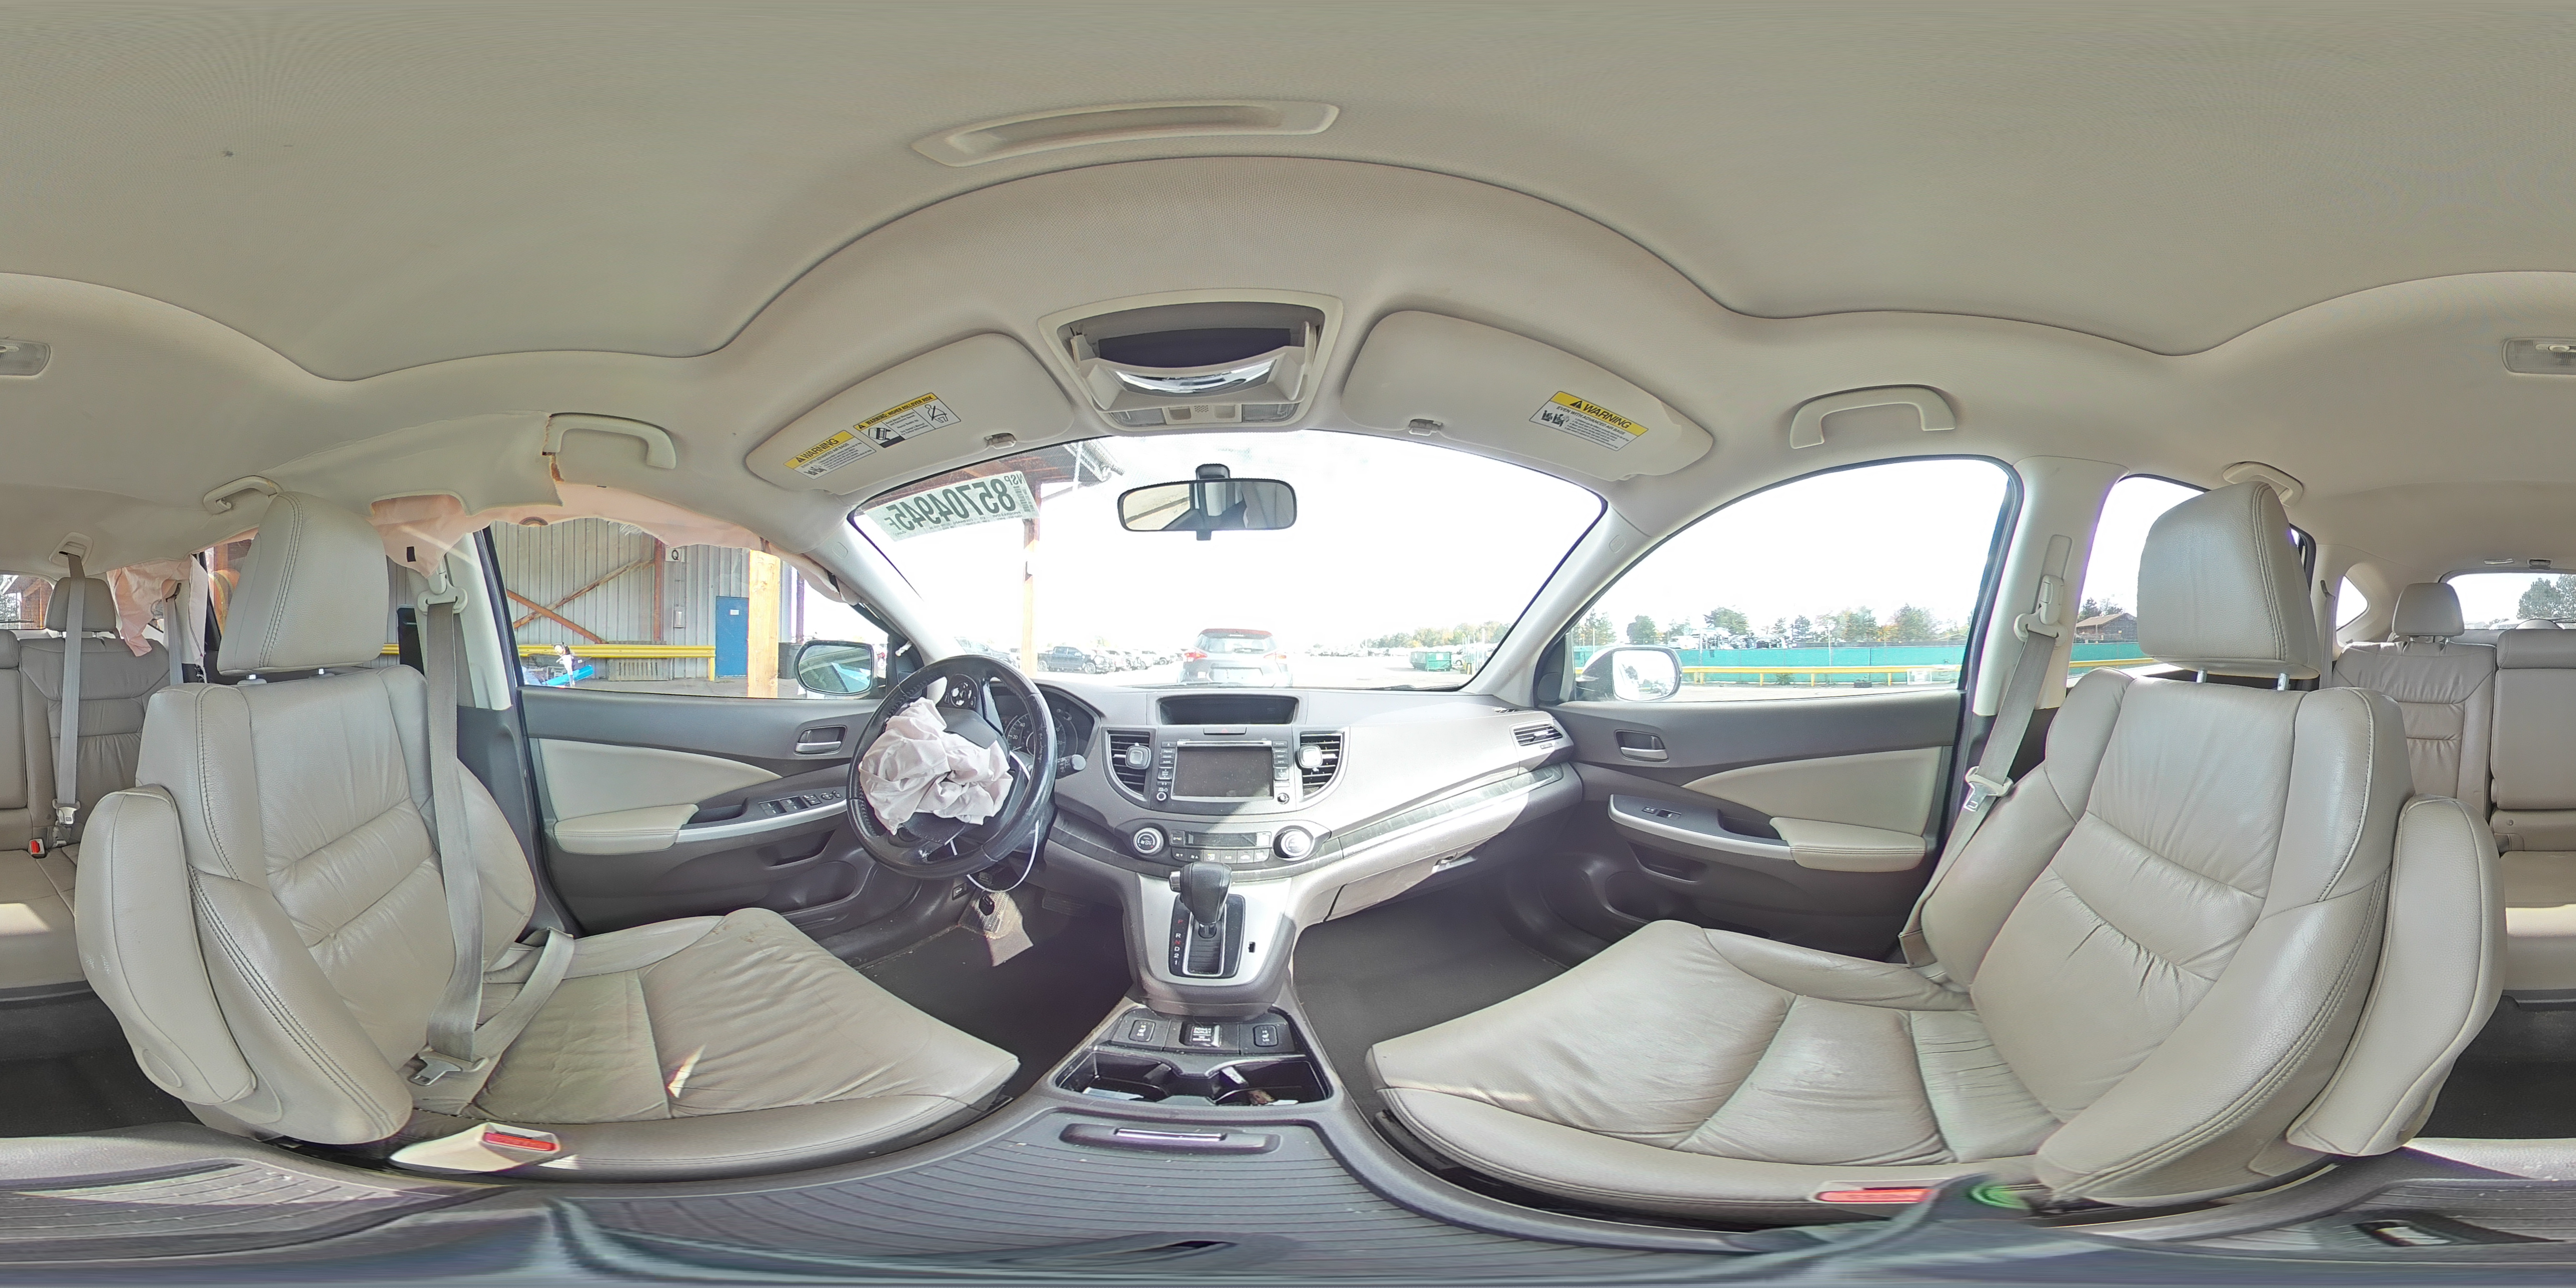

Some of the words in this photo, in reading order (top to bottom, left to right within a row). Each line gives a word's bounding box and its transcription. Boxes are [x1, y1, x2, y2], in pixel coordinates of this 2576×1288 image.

[1582, 414, 1606, 427] ADVANCED
[1583, 403, 1632, 429] WARNING
[801, 438, 840, 459] WARNING
[816, 450, 833, 461] ADVANCED
[671, 550, 679, 561] Q
